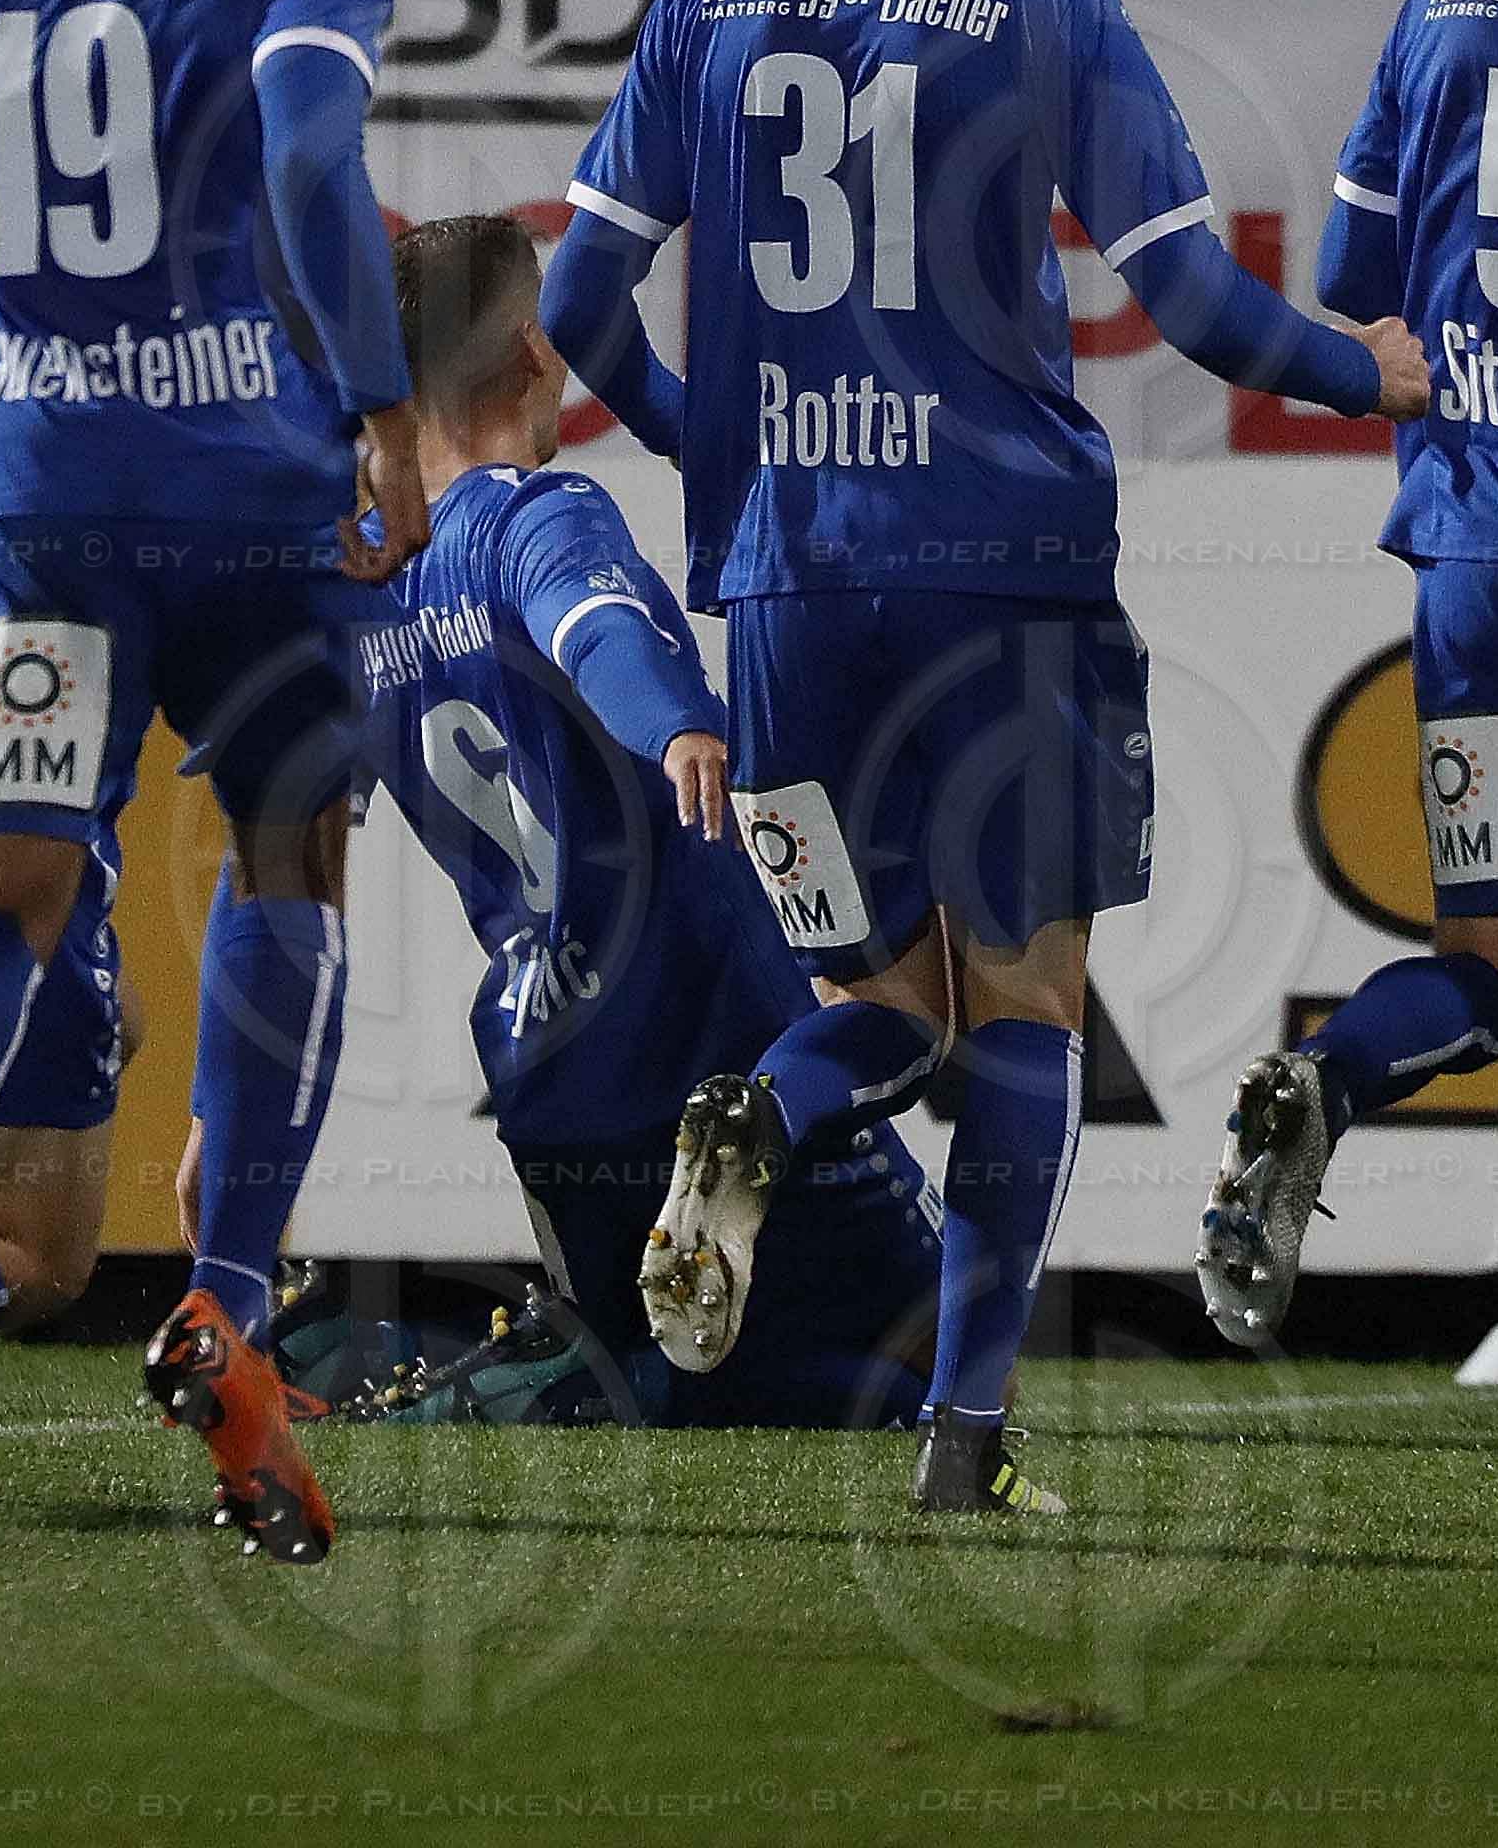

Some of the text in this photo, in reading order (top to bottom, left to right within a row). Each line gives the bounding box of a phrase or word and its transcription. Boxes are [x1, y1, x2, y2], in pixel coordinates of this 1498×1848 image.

[701, 1, 791, 21] HARTBERG
[1425, 0, 1498, 21] HARTBERG
[744, 53, 918, 313] 31
[759, 362, 939, 468] Rotter
